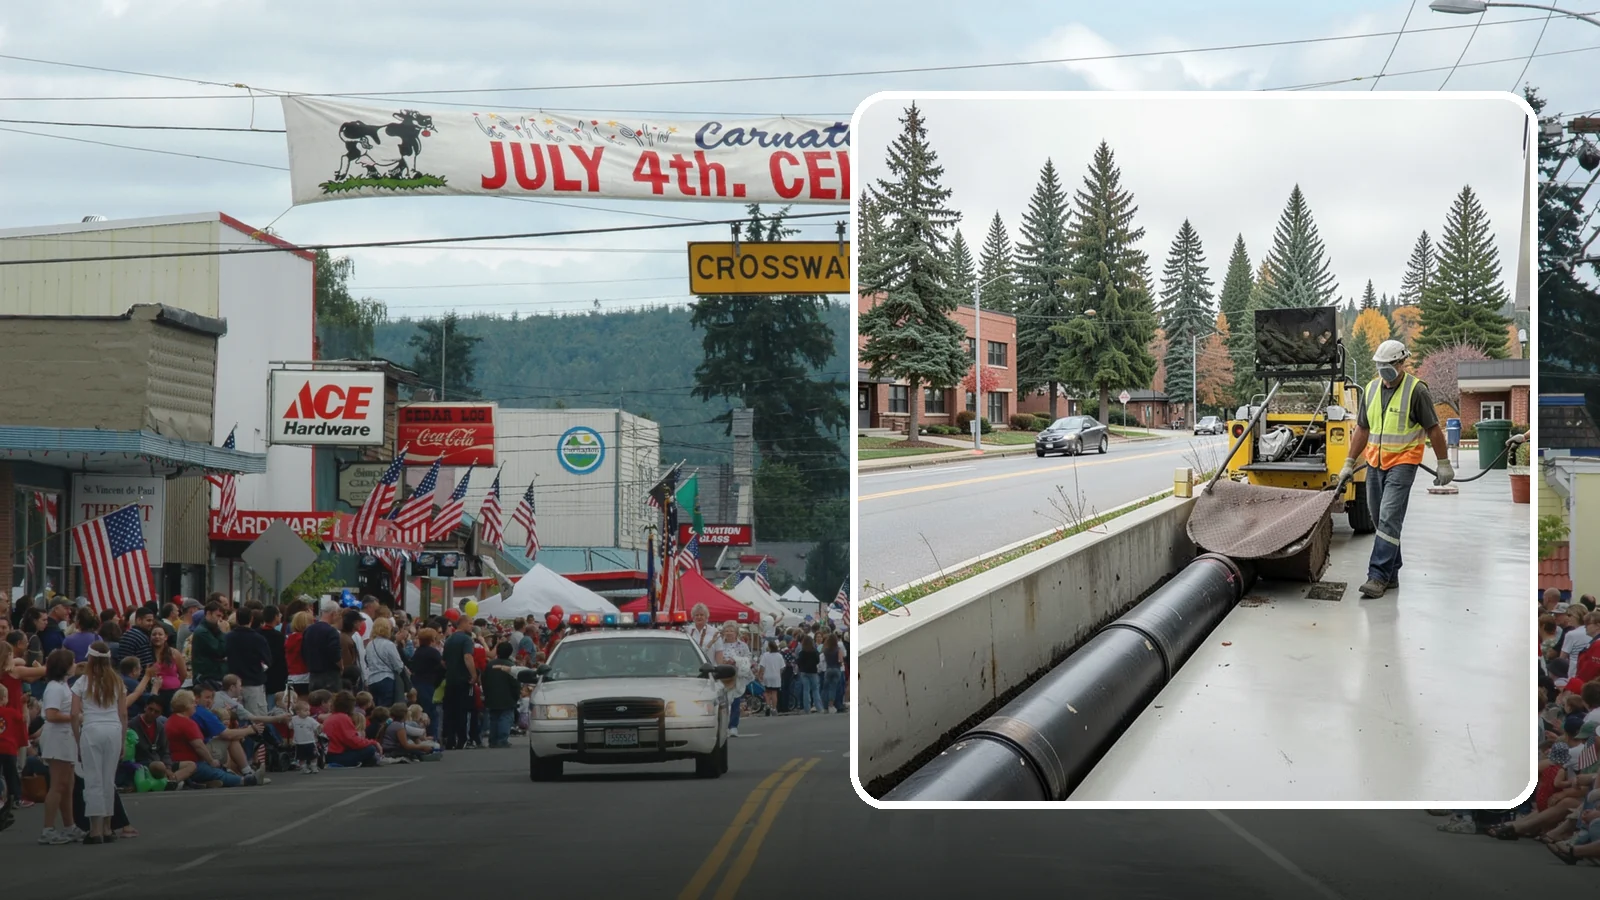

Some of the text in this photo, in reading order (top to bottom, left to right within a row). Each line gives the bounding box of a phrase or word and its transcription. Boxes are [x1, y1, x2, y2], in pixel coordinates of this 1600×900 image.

[481, 141, 605, 192] JULY
[632, 150, 746, 198] 4th.
[697, 254, 850, 280] CROSSWA
[282, 380, 373, 420] ACE
[405, 409, 485, 422] CEDAR LOG
[283, 421, 371, 436] Hardware
[416, 428, 476, 447] Coca-Cola
[353, 467, 385, 479] Simpl
[83, 485, 155, 495] St. Vincent de Paul
[81, 503, 153, 522] THT
[213, 516, 331, 535] HARDARE
[688, 526, 741, 535] CRNATION
[699, 535, 730, 543] GLASS
